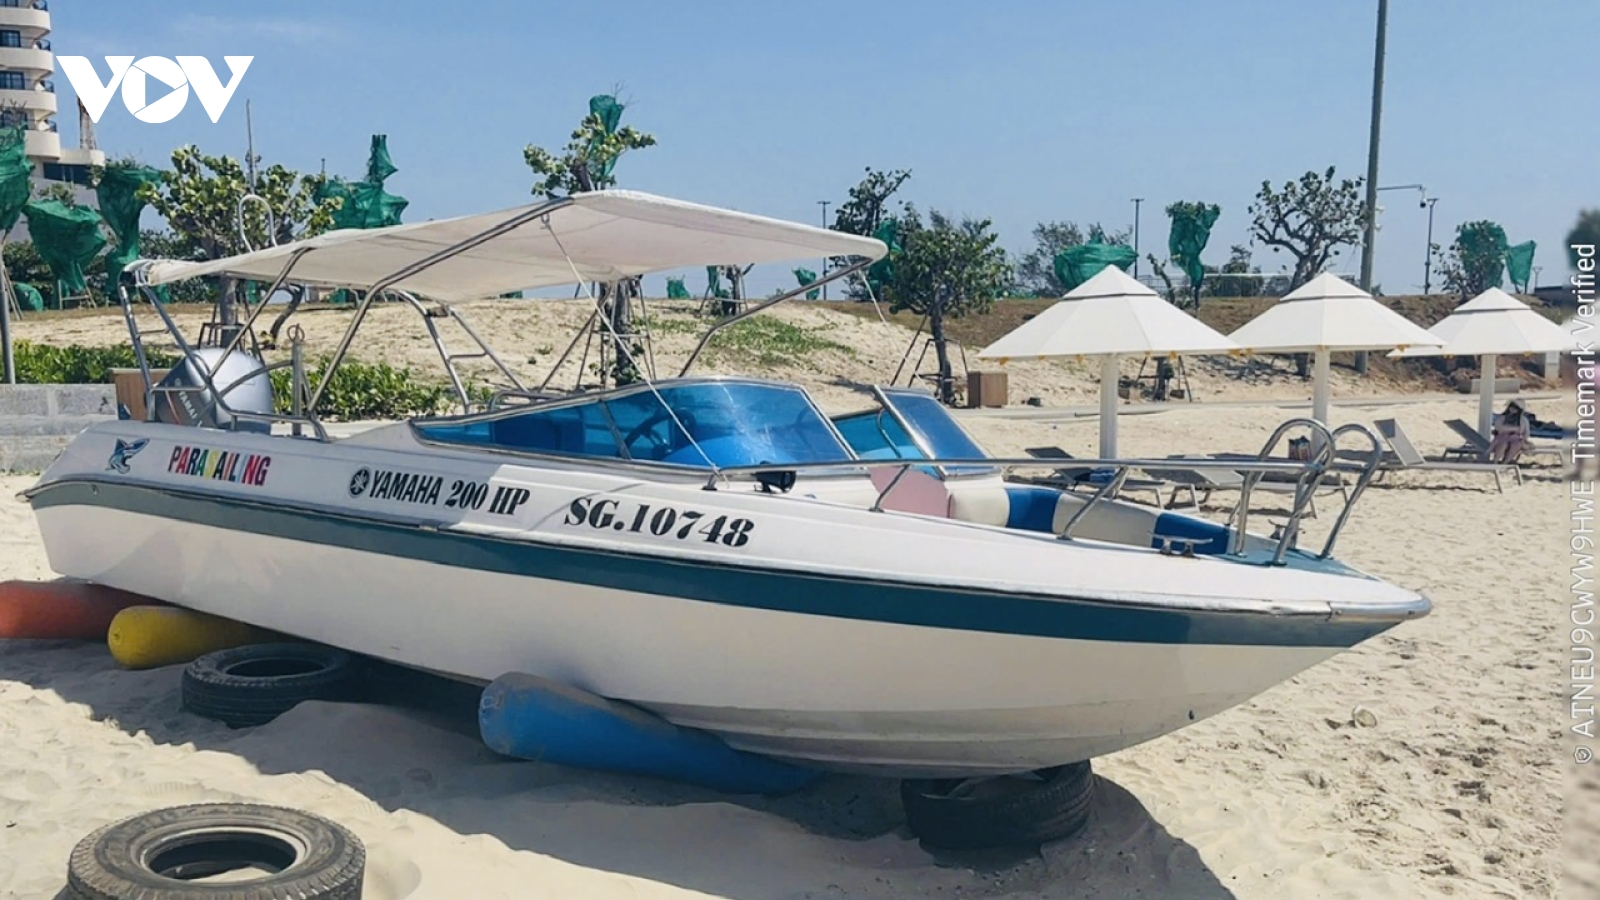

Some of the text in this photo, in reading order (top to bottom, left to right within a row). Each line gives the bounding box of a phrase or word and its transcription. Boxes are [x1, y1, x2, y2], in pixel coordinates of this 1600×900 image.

[168, 445, 271, 486] PARASAILING
[369, 470, 531, 516] YAMAHA 200 HP
[563, 496, 755, 547] SG.10748
